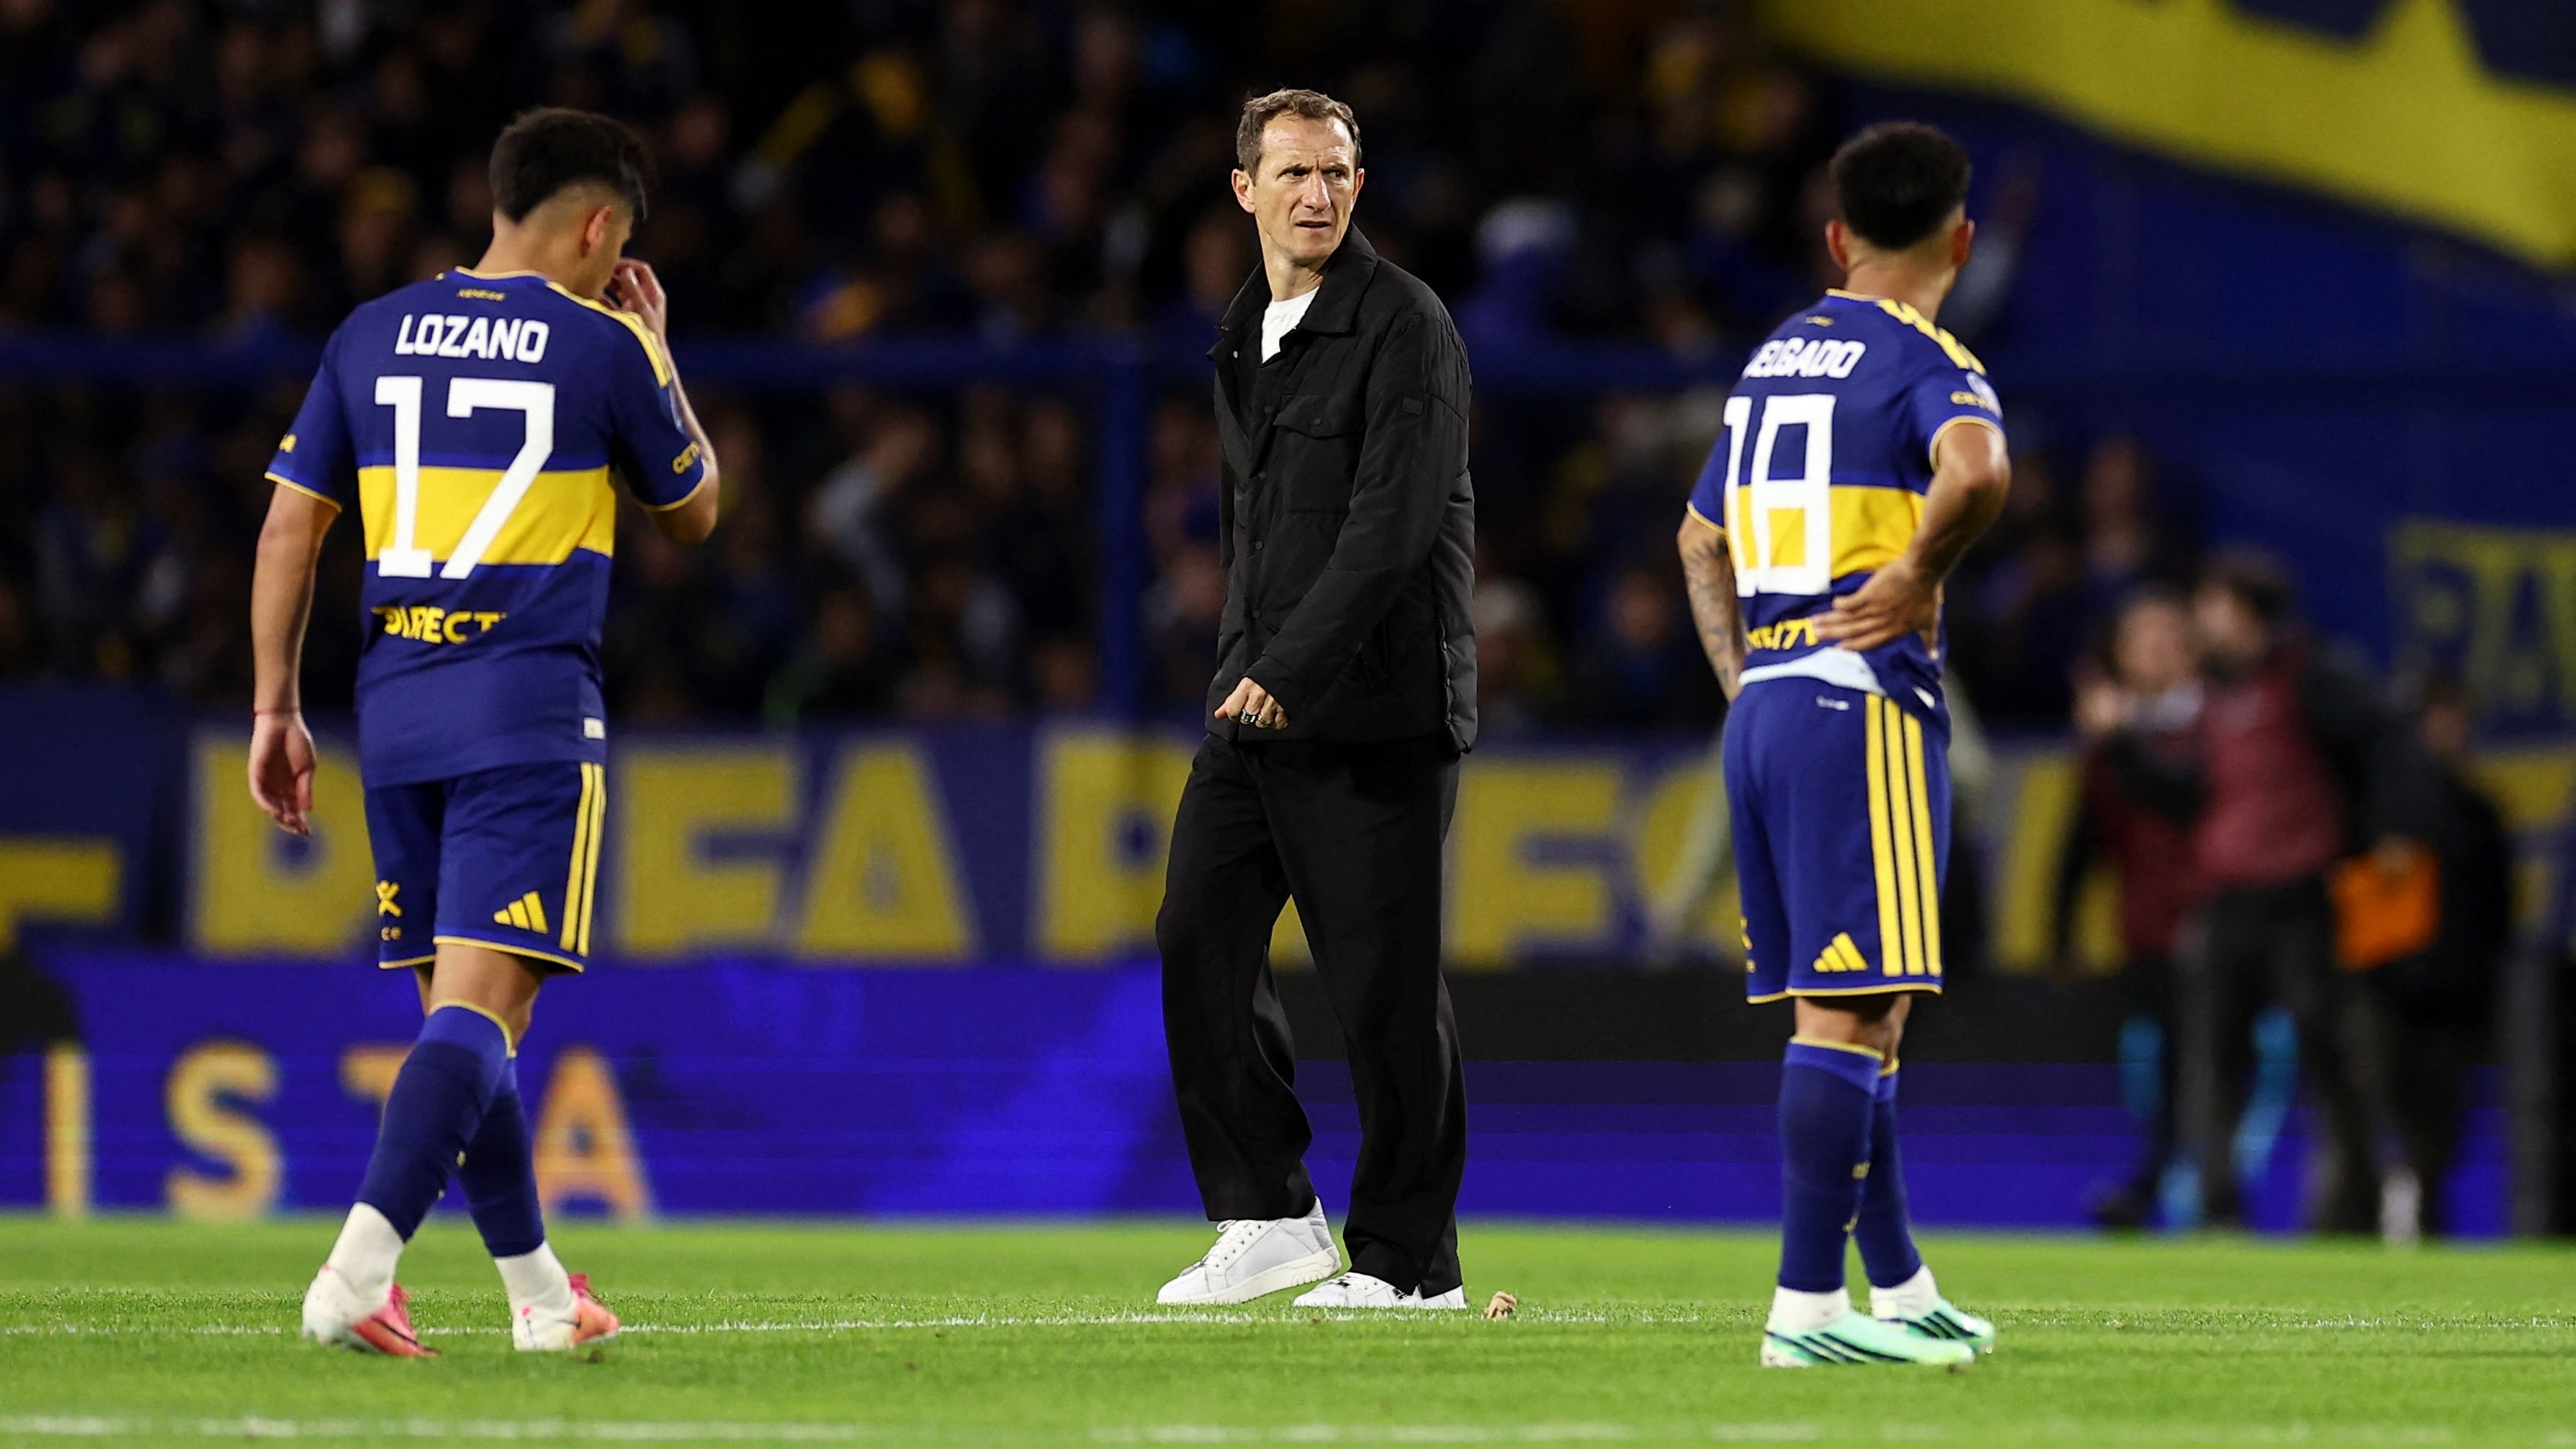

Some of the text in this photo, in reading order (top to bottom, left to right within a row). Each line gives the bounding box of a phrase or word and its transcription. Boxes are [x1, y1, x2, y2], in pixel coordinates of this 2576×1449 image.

[394, 313, 550, 363] LOZANO
[374, 376, 555, 579] 17
[1723, 394, 1837, 597] 18
